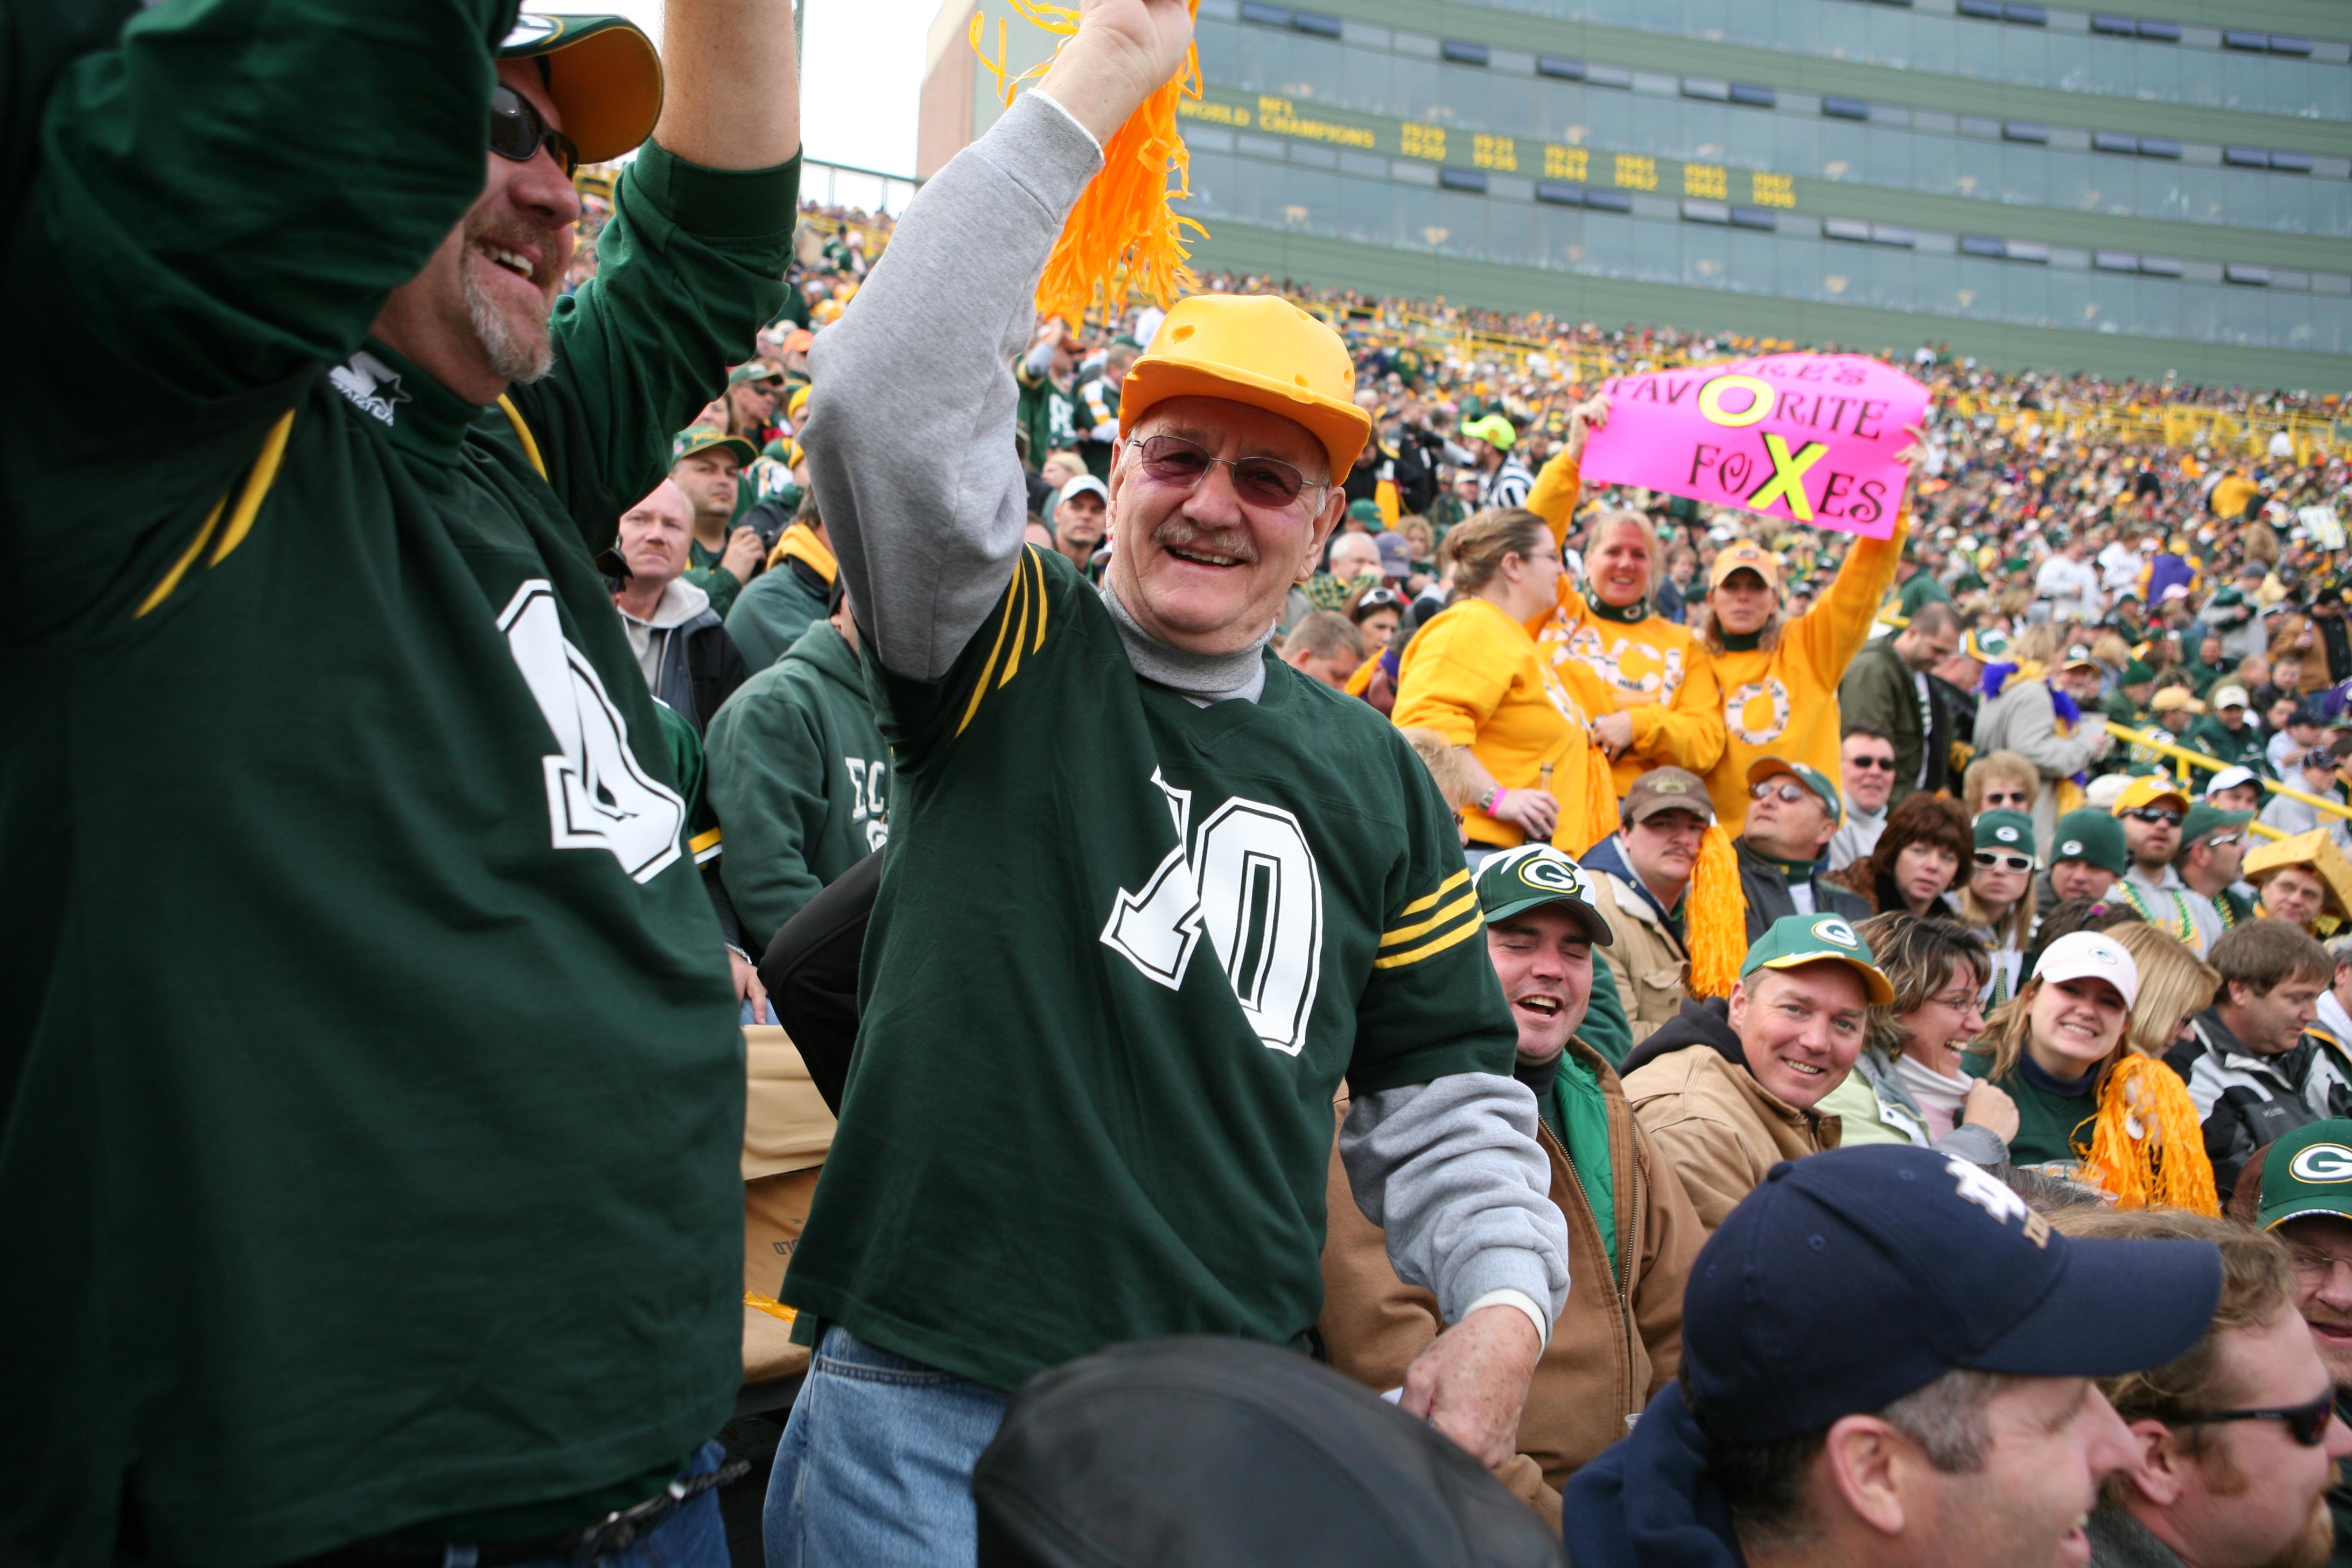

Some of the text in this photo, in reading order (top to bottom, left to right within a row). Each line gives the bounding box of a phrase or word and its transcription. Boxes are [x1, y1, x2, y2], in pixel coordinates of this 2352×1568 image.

[1178, 97, 1375, 149] WORLD CHAMPIONS
[1688, 431, 1887, 523] FOXES
[844, 757, 887, 818] EC
